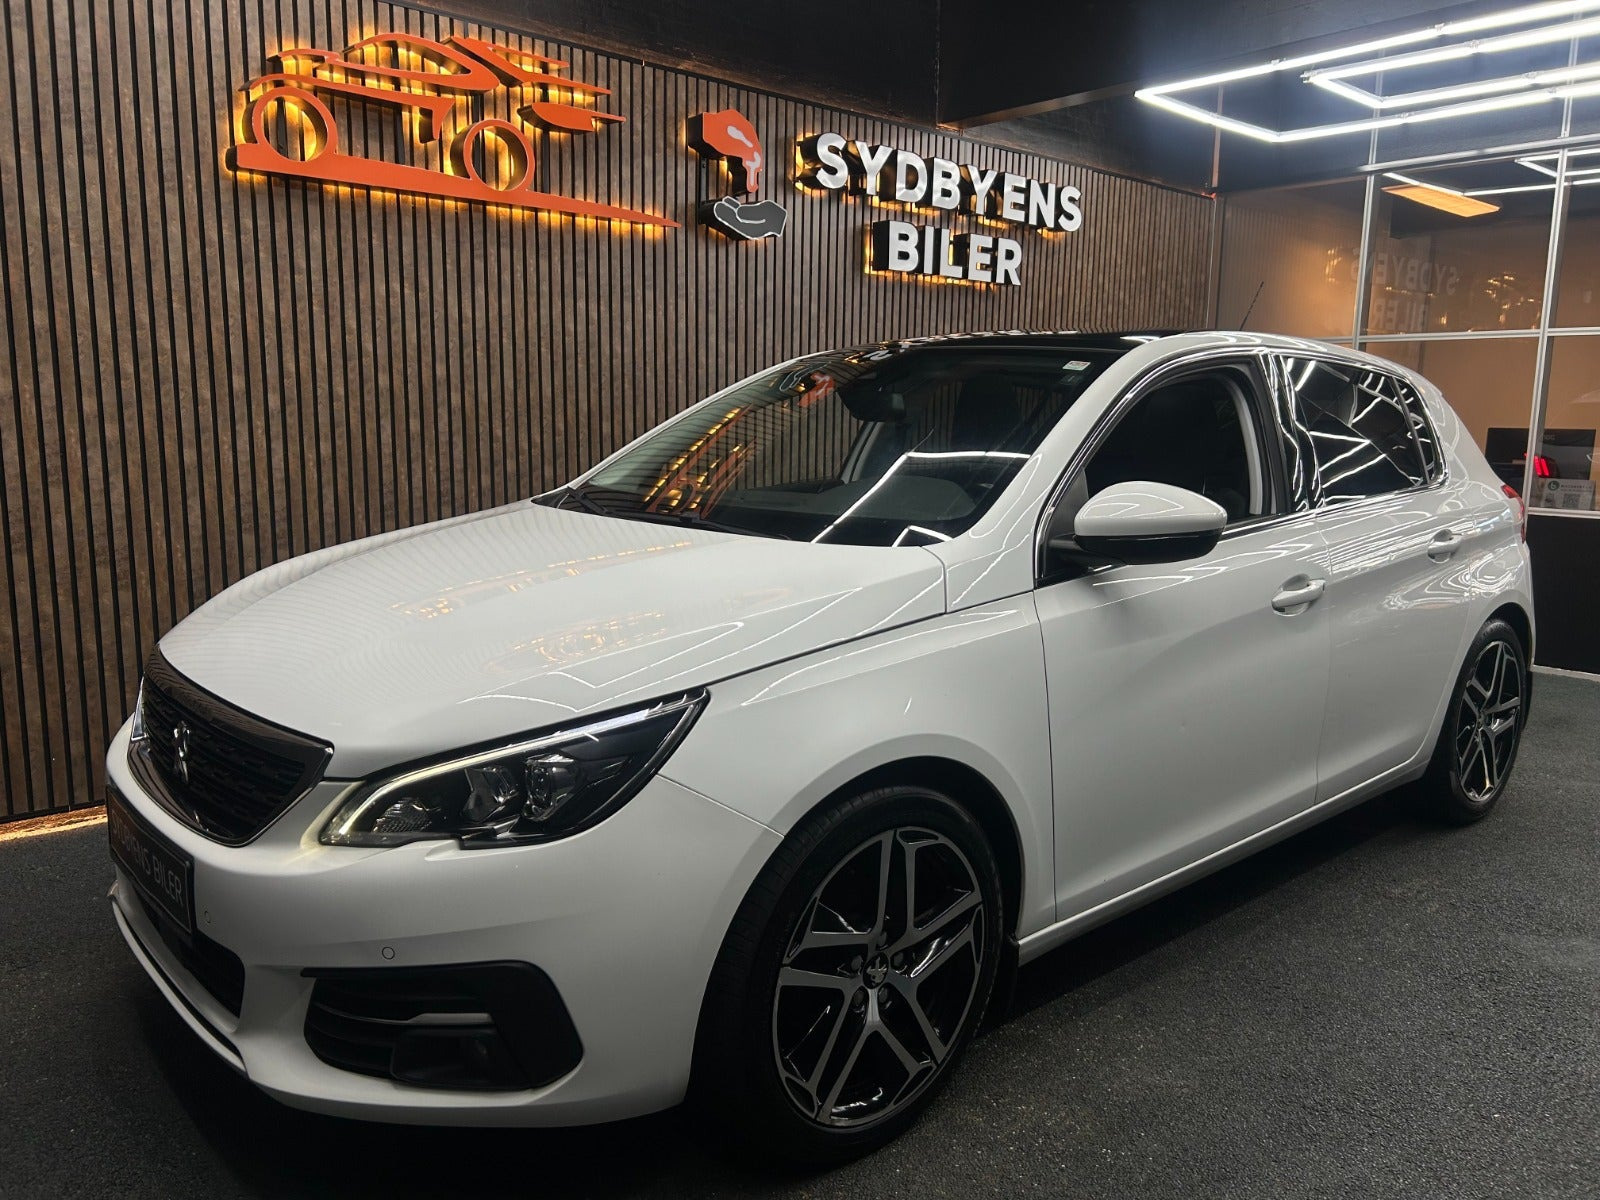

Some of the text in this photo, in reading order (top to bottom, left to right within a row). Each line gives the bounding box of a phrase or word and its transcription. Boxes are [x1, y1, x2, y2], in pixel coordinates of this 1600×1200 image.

[816, 132, 1082, 232] SYDBYENS
[888, 220, 1023, 286] BILER
[153, 854, 183, 905] BILER
